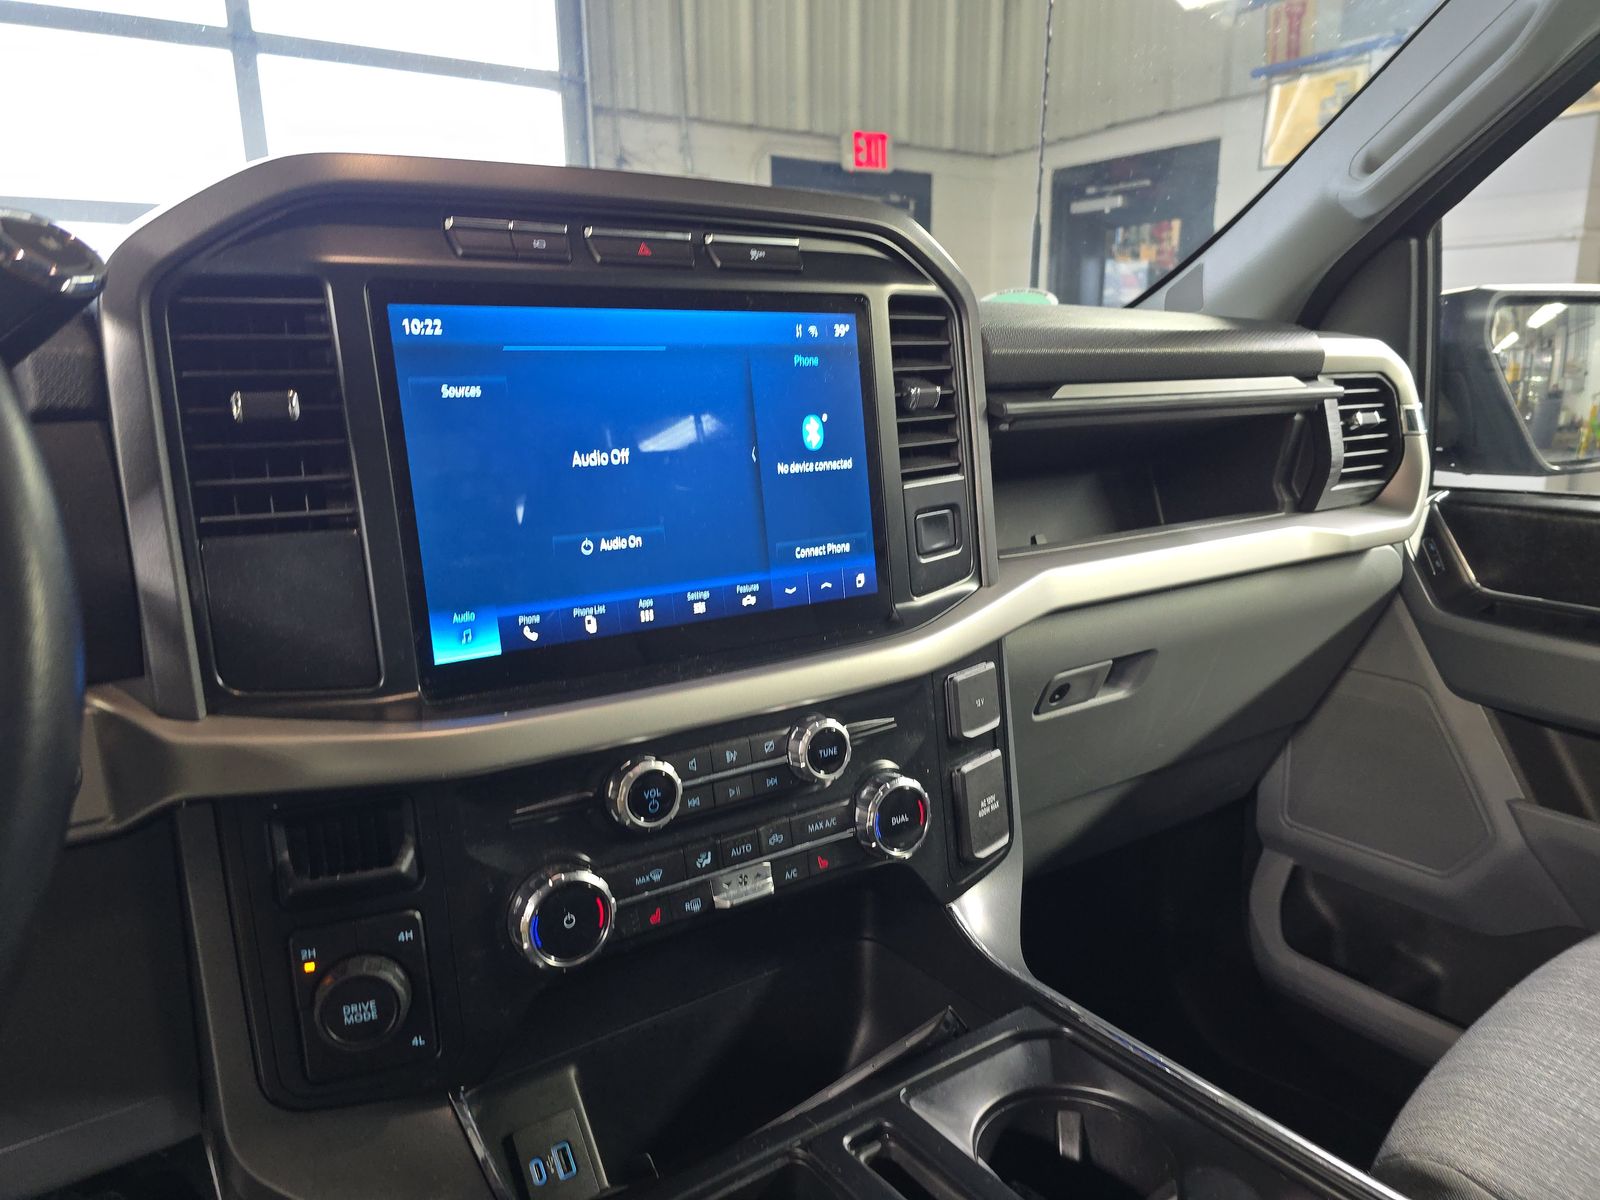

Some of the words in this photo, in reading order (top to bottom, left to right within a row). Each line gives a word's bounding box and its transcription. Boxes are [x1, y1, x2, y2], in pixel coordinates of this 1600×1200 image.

[853, 131, 888, 170] EXIT
[402, 318, 443, 336] 10:22
[793, 354, 819, 368] Phone
[440, 383, 482, 399] Sources
[572, 449, 609, 468] Audio
[610, 447, 630, 466] Off
[777, 461, 789, 475] No
[789, 460, 815, 474] device
[814, 456, 853, 472] connected
[600, 536, 627, 552] Audio
[628, 534, 642, 549] On
[795, 545, 827, 560] Connect
[827, 542, 850, 556] Phone
[686, 590, 710, 602] Settings
[736, 583, 760, 595] Features
[638, 597, 654, 609] Apps
[573, 606, 593, 618] Phone
[593, 603, 606, 615] List
[452, 611, 476, 625] Audio
[518, 614, 541, 627] Phone
[818, 745, 839, 759] TUNE
[643, 787, 662, 800] VOL
[807, 821, 823, 833] MAX
[825, 816, 837, 828] A/C
[891, 812, 909, 826] DUAL
[730, 843, 752, 858] AUTO
[635, 875, 651, 887] MAX
[785, 867, 798, 881] A/C
[398, 930, 413, 942] 4H
[342, 999, 377, 1016] DRIVE
[343, 1011, 378, 1026] MODE
[411, 1035, 426, 1047] 4L
